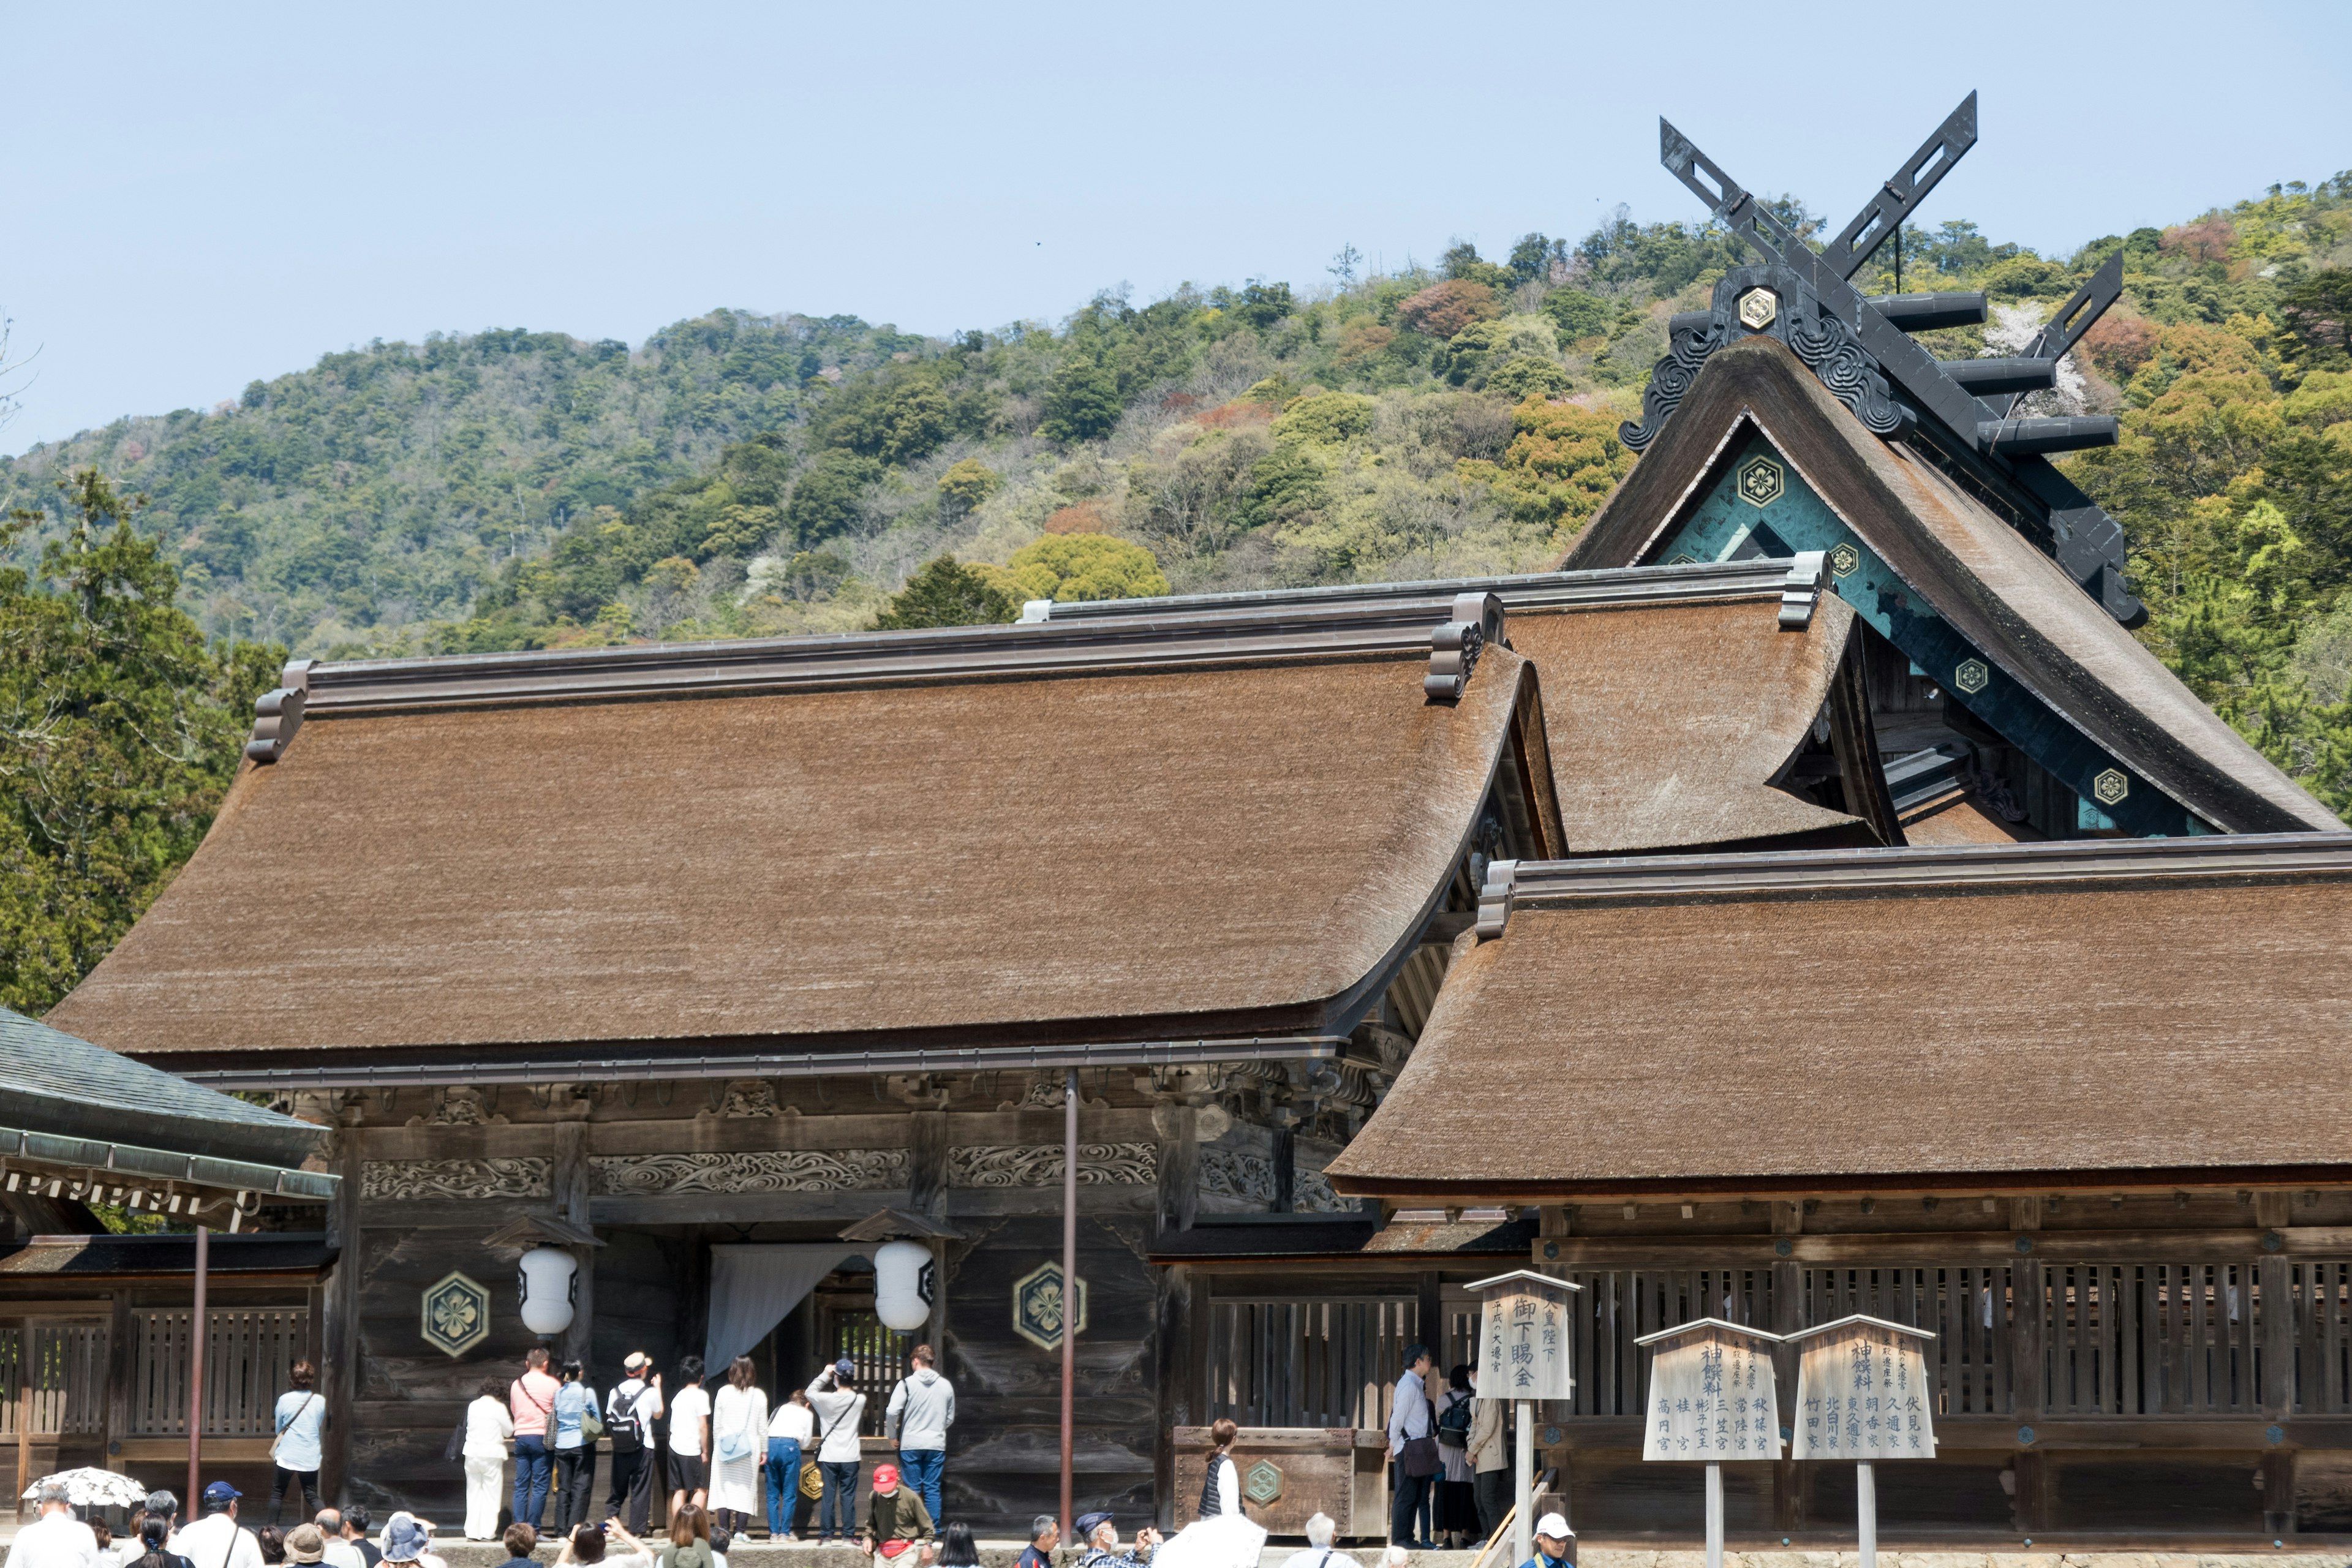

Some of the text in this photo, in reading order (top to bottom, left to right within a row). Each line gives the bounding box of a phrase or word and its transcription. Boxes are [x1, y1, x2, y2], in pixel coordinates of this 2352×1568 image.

[1491, 1301, 1502, 1372] 平成の大遷宮
[1510, 1298, 1536, 1387] 御下賜金
[1542, 1292, 1558, 1362] 天皇陛下
[1700, 1343, 1722, 1398] 神饌料
[1732, 1341, 1741, 1388] 本殿遷座祭
[1746, 1341, 1755, 1390] 平成の大遷宮
[1851, 1339, 1872, 1392] 神饌料
[1882, 1338, 1893, 1388] 本殿遷座祭
[1897, 1338, 1907, 1390] 平成の大遷宮
[1657, 1398, 1670, 1451] 高円宮
[1695, 1399, 1709, 1449] 彬子女王
[1715, 1399, 1728, 1450] 三笠宮
[1734, 1398, 1748, 1450] 常陸宮
[1752, 1398, 1768, 1451] 秋篠宮
[1804, 1396, 1820, 1449] 竹田家
[1826, 1396, 1840, 1449] 北白川家
[1845, 1396, 1860, 1449] 東久邇家
[1863, 1396, 1881, 1447] 朝香家
[1885, 1396, 1901, 1448] 久邇家
[1905, 1396, 1921, 1449] 伏見家
